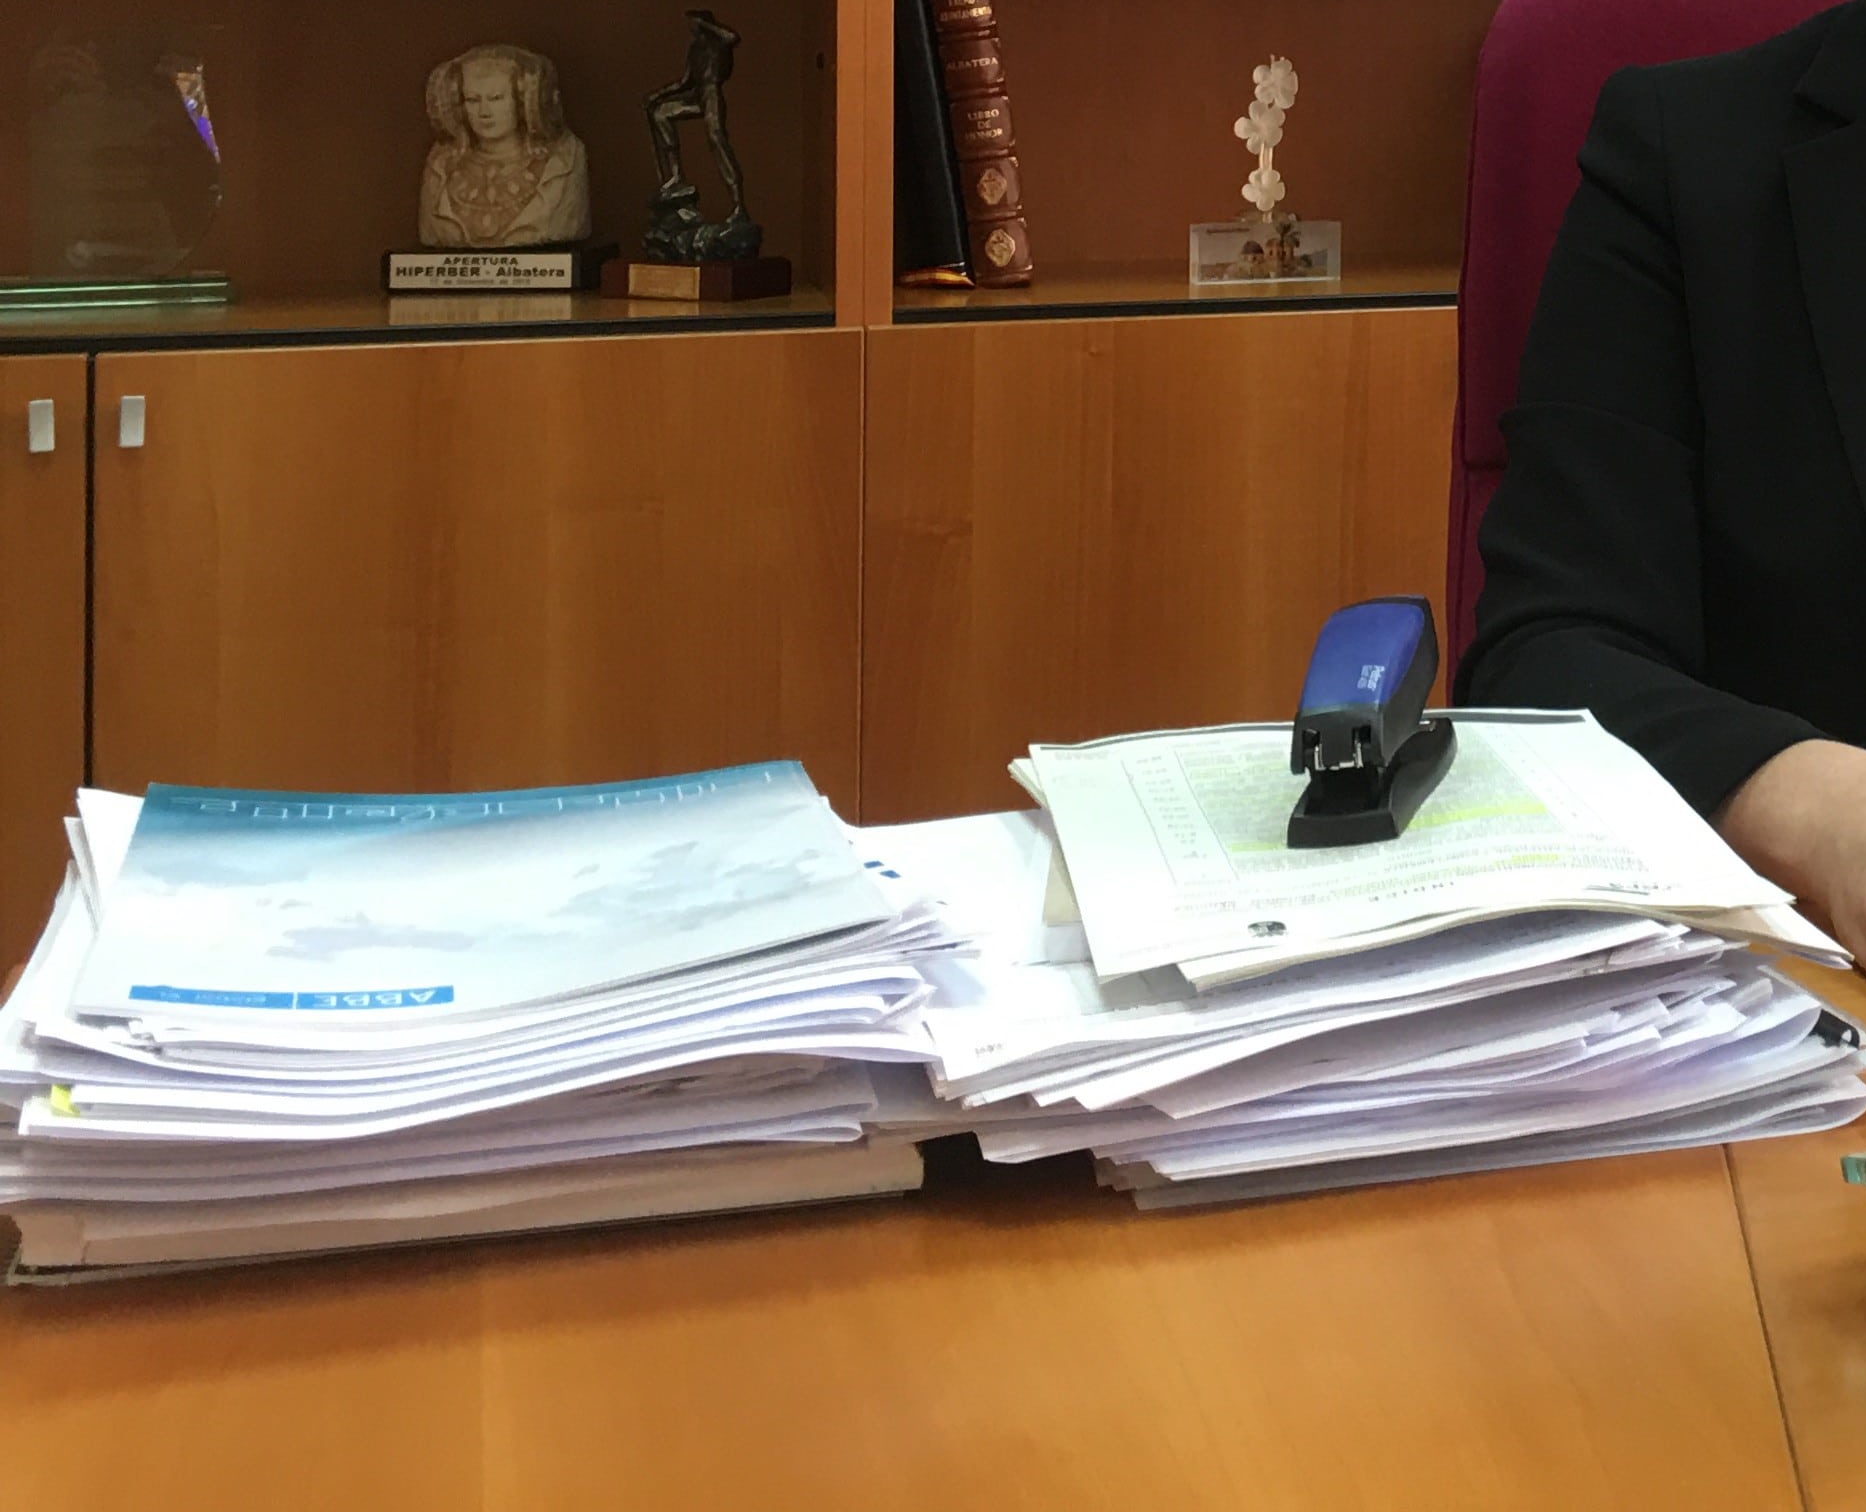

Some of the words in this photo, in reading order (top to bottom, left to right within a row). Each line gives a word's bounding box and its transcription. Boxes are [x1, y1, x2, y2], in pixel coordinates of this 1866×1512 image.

[946, 56, 999, 70] ALBATERA
[443, 257, 519, 265] APERTURA
[396, 267, 481, 277] HIPERBER
[495, 267, 565, 277] Albatera
[312, 989, 436, 1008] ABBE
